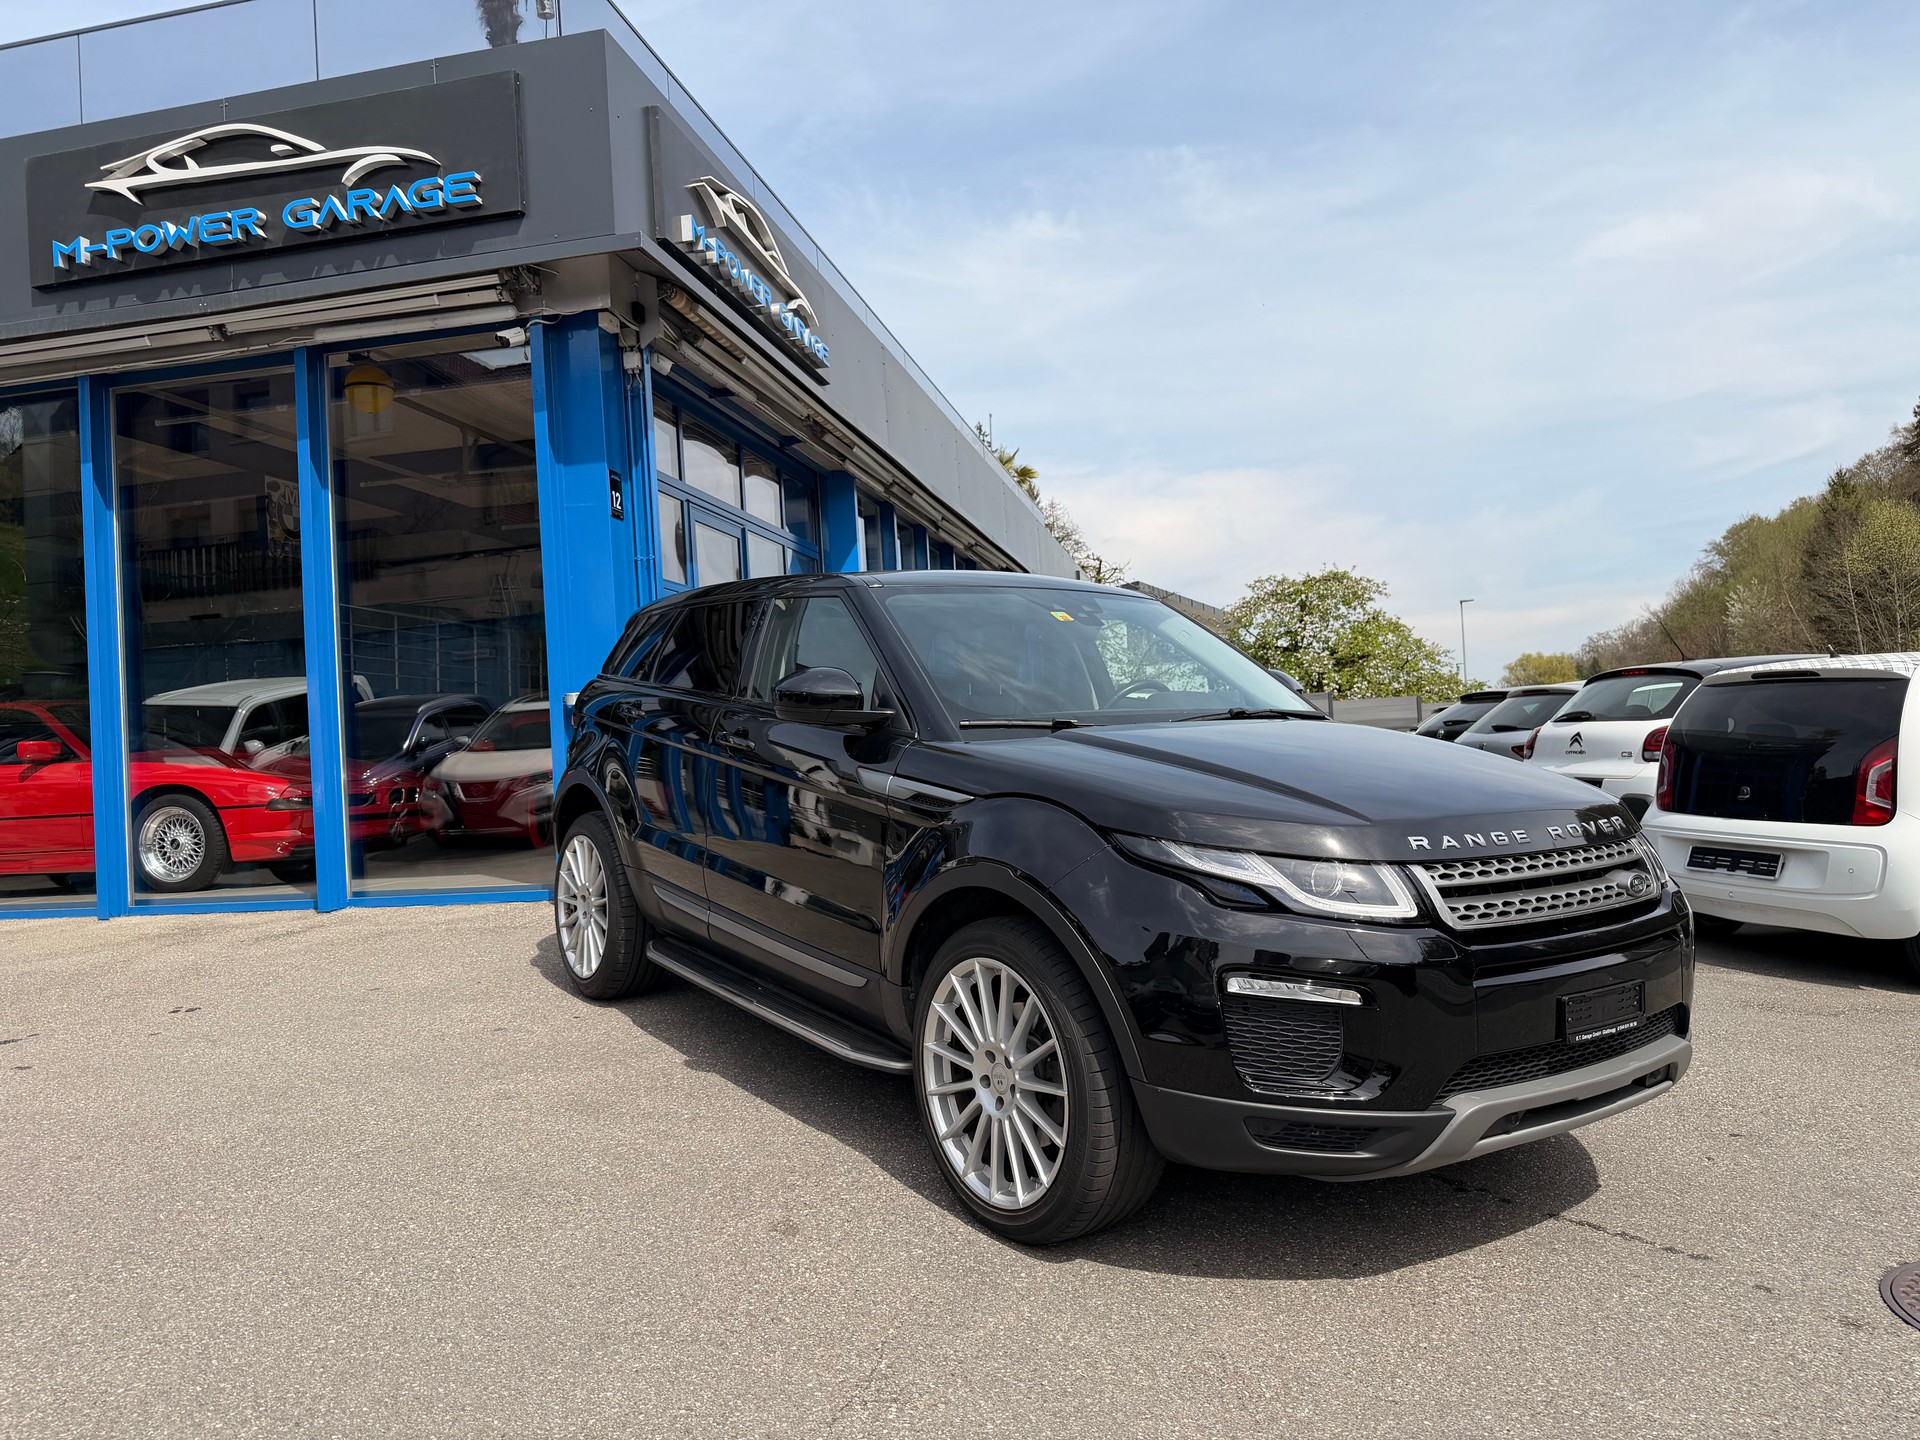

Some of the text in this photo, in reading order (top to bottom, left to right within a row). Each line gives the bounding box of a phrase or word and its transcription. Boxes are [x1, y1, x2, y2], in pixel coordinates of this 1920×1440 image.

[52, 170, 479, 269] M-POWER GARAGE
[691, 214, 772, 306] M-POWER
[612, 490, 621, 509] 12
[1408, 815, 1626, 850] RANGE ROVER
